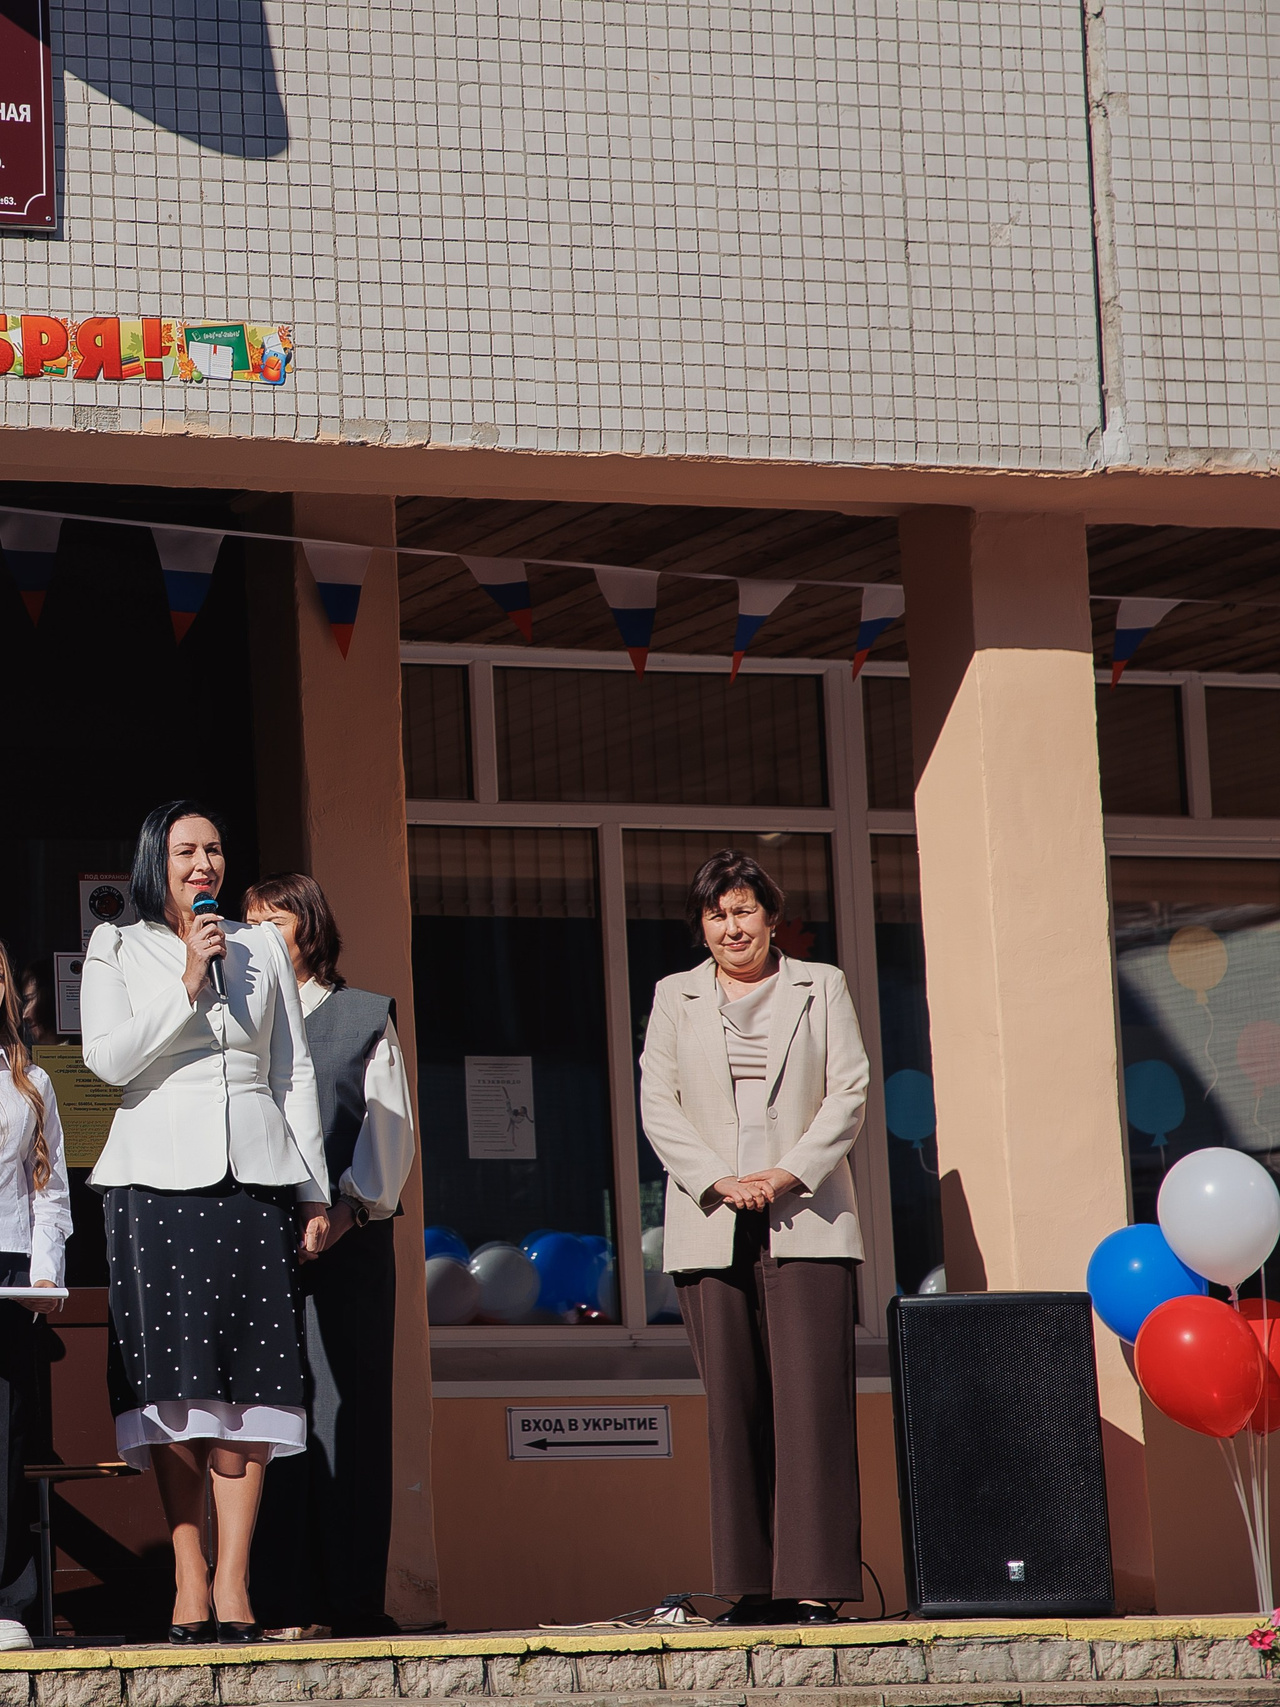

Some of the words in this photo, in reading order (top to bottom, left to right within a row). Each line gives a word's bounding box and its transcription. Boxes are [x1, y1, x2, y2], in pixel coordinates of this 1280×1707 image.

[521, 1418, 565, 1434] ВХОД
[568, 1418, 579, 1432] В
[581, 1417, 658, 1432] УКРЫТИЕ
